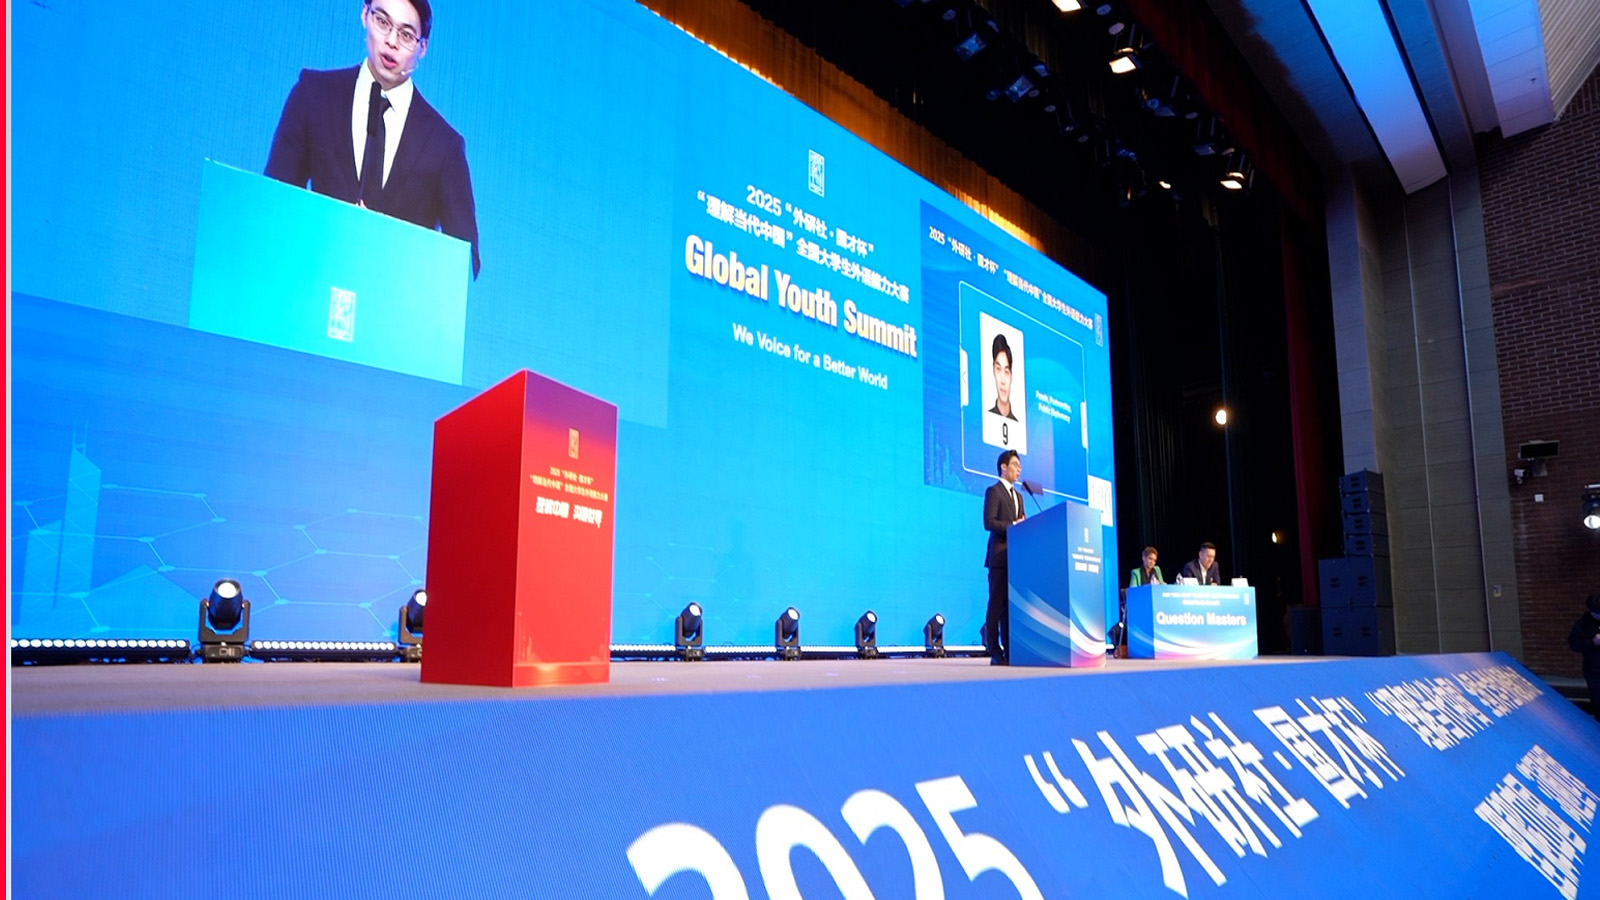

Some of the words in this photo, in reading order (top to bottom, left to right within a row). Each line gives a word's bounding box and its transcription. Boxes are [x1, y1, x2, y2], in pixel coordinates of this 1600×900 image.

[746, 184, 782, 217] 2025
[929, 226, 945, 245] 2025
[685, 234, 768, 301] Global
[774, 268, 838, 327] Youth
[843, 299, 917, 358] Summit
[732, 323, 754, 345] We
[757, 331, 791, 358] Voice
[794, 344, 810, 365] for
[813, 355, 821, 368] a
[823, 354, 856, 380] Better
[858, 366, 888, 390] World
[1002, 422, 1009, 446] 9
[1156, 611, 1205, 626] Question
[1206, 612, 1247, 627] Masters
[626, 775, 1045, 900] 25
